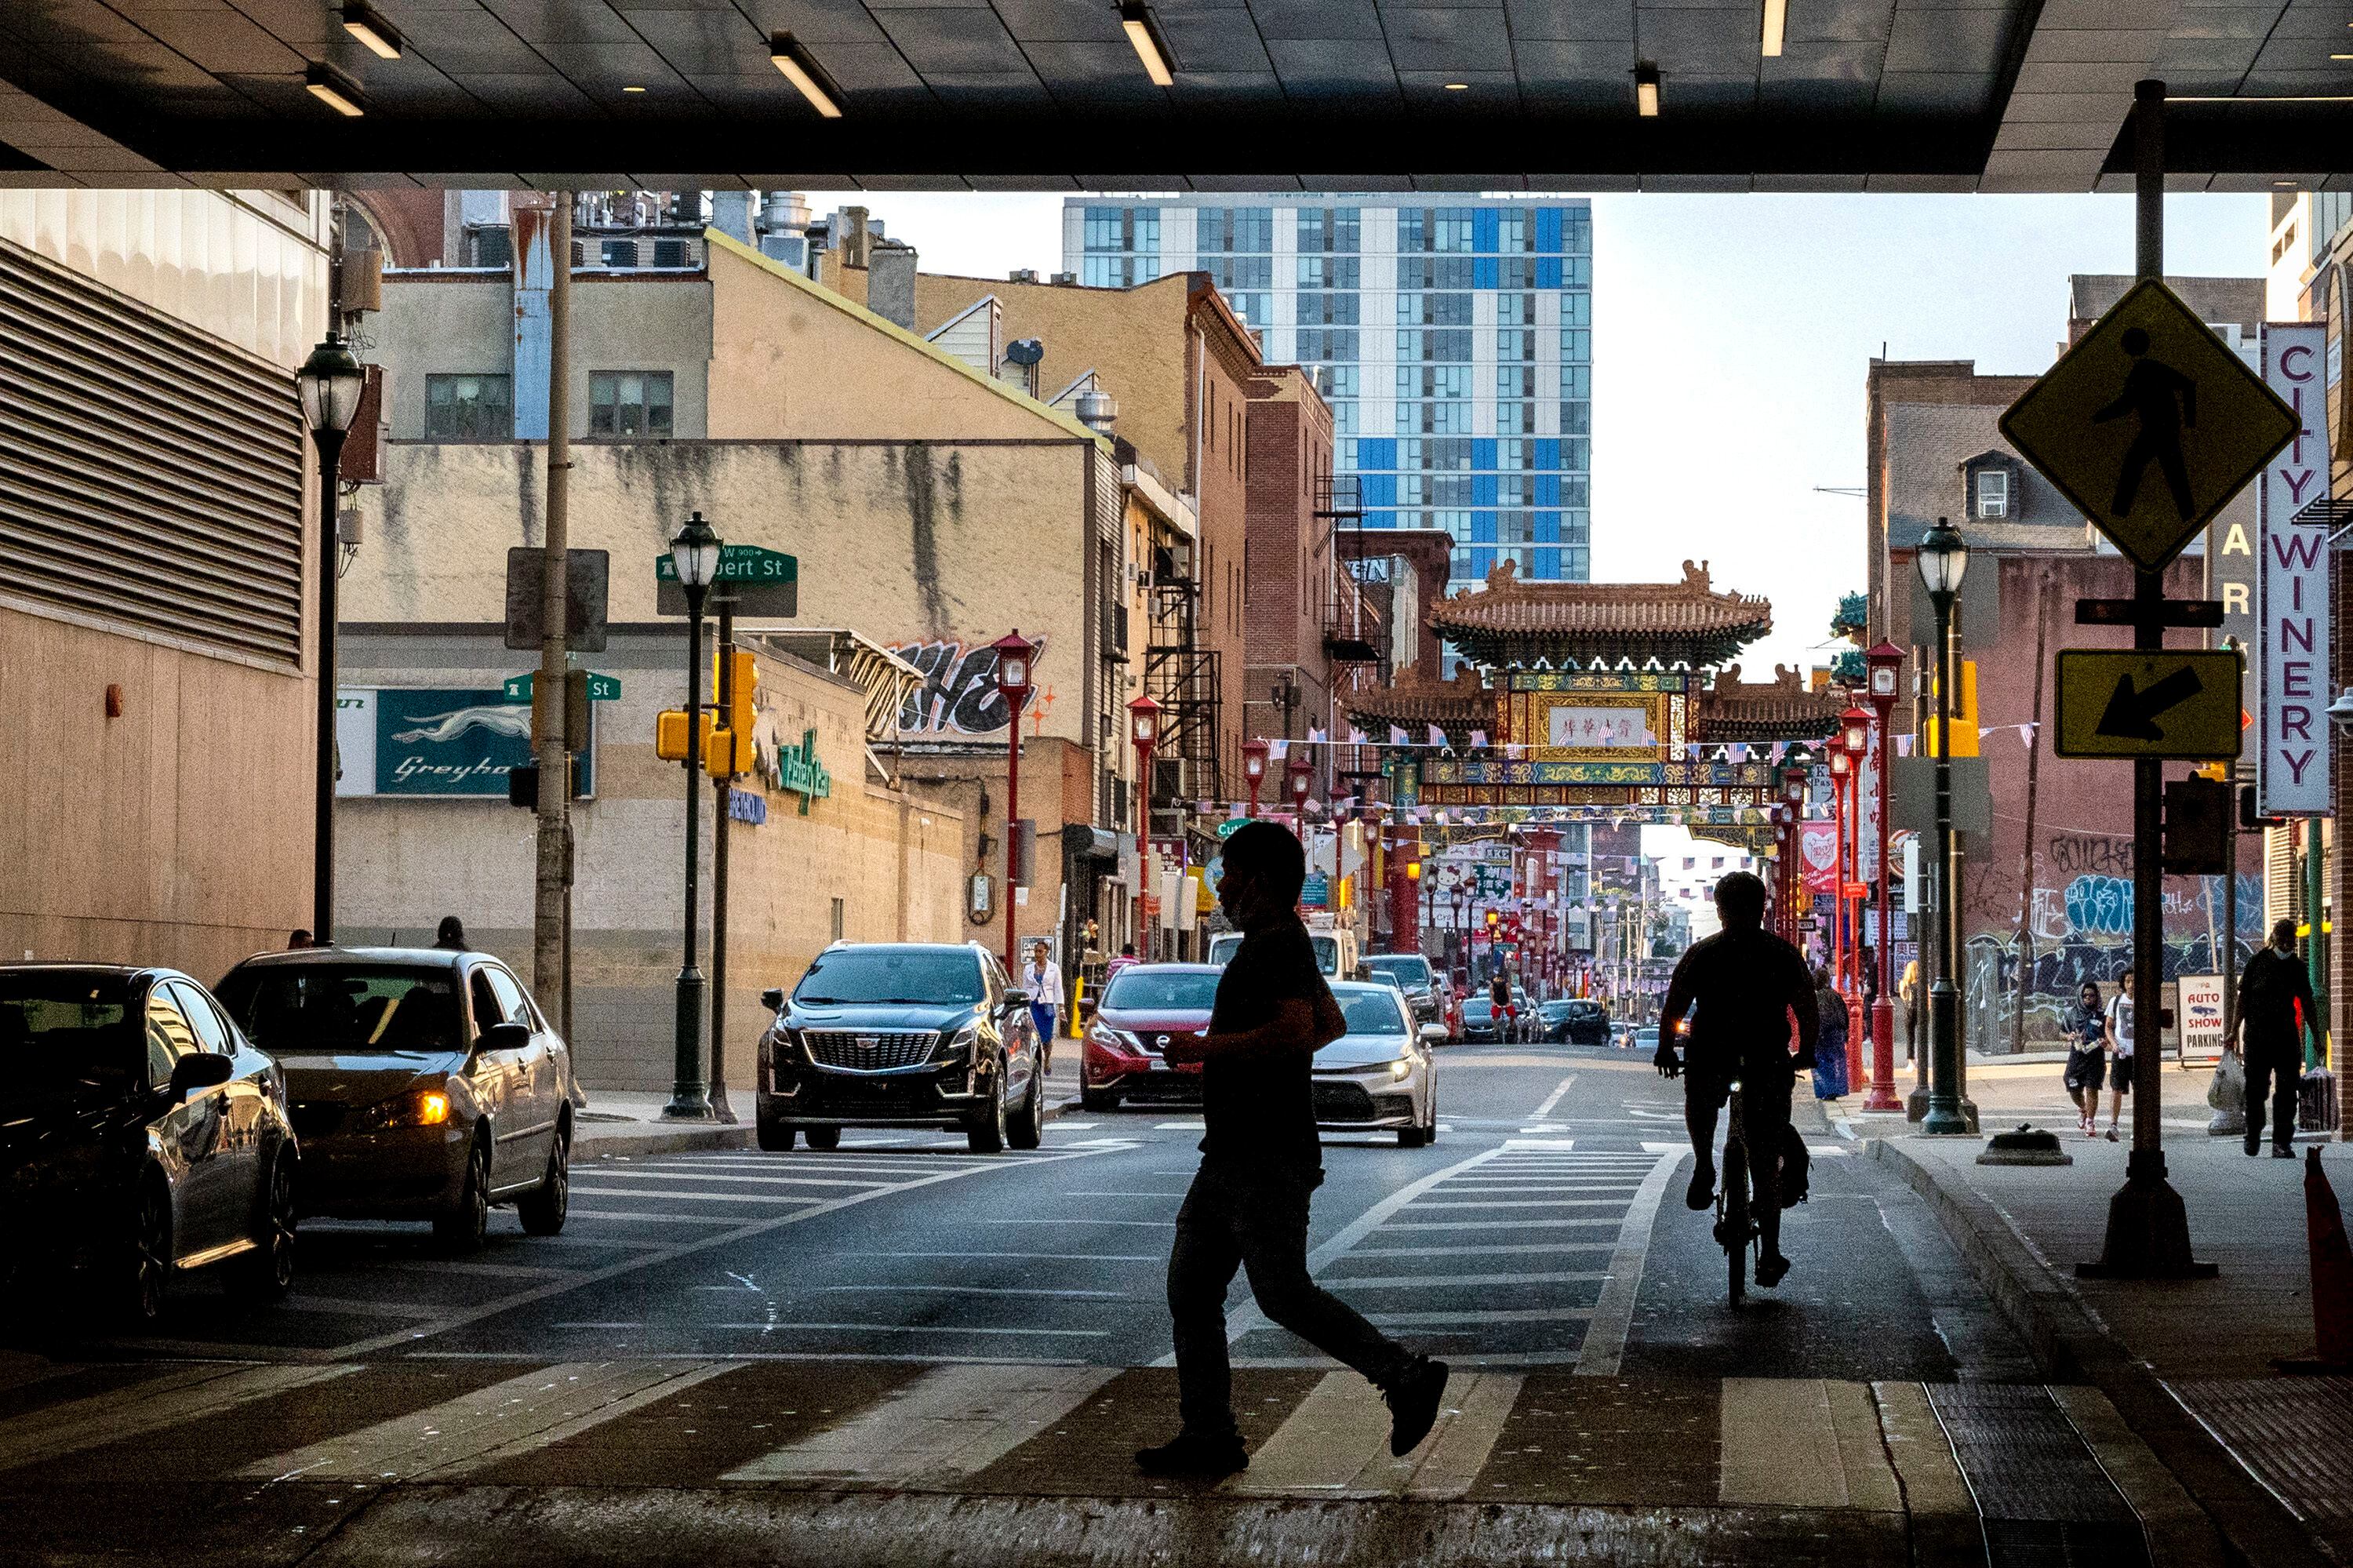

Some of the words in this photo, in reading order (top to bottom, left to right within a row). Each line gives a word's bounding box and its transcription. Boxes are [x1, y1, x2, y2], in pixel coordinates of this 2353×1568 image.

[2280, 346, 2315, 505] CITY
[724, 548, 733, 558] W
[763, 559, 783, 575] St
[2271, 533, 2326, 785] WINERY
[593, 682, 609, 696] St
[392, 756, 512, 784] Greyho
[2188, 993, 2220, 1004] AUTO
[2188, 1018, 2222, 1028] SHOW
[2187, 1034, 2223, 1048] PARKING
